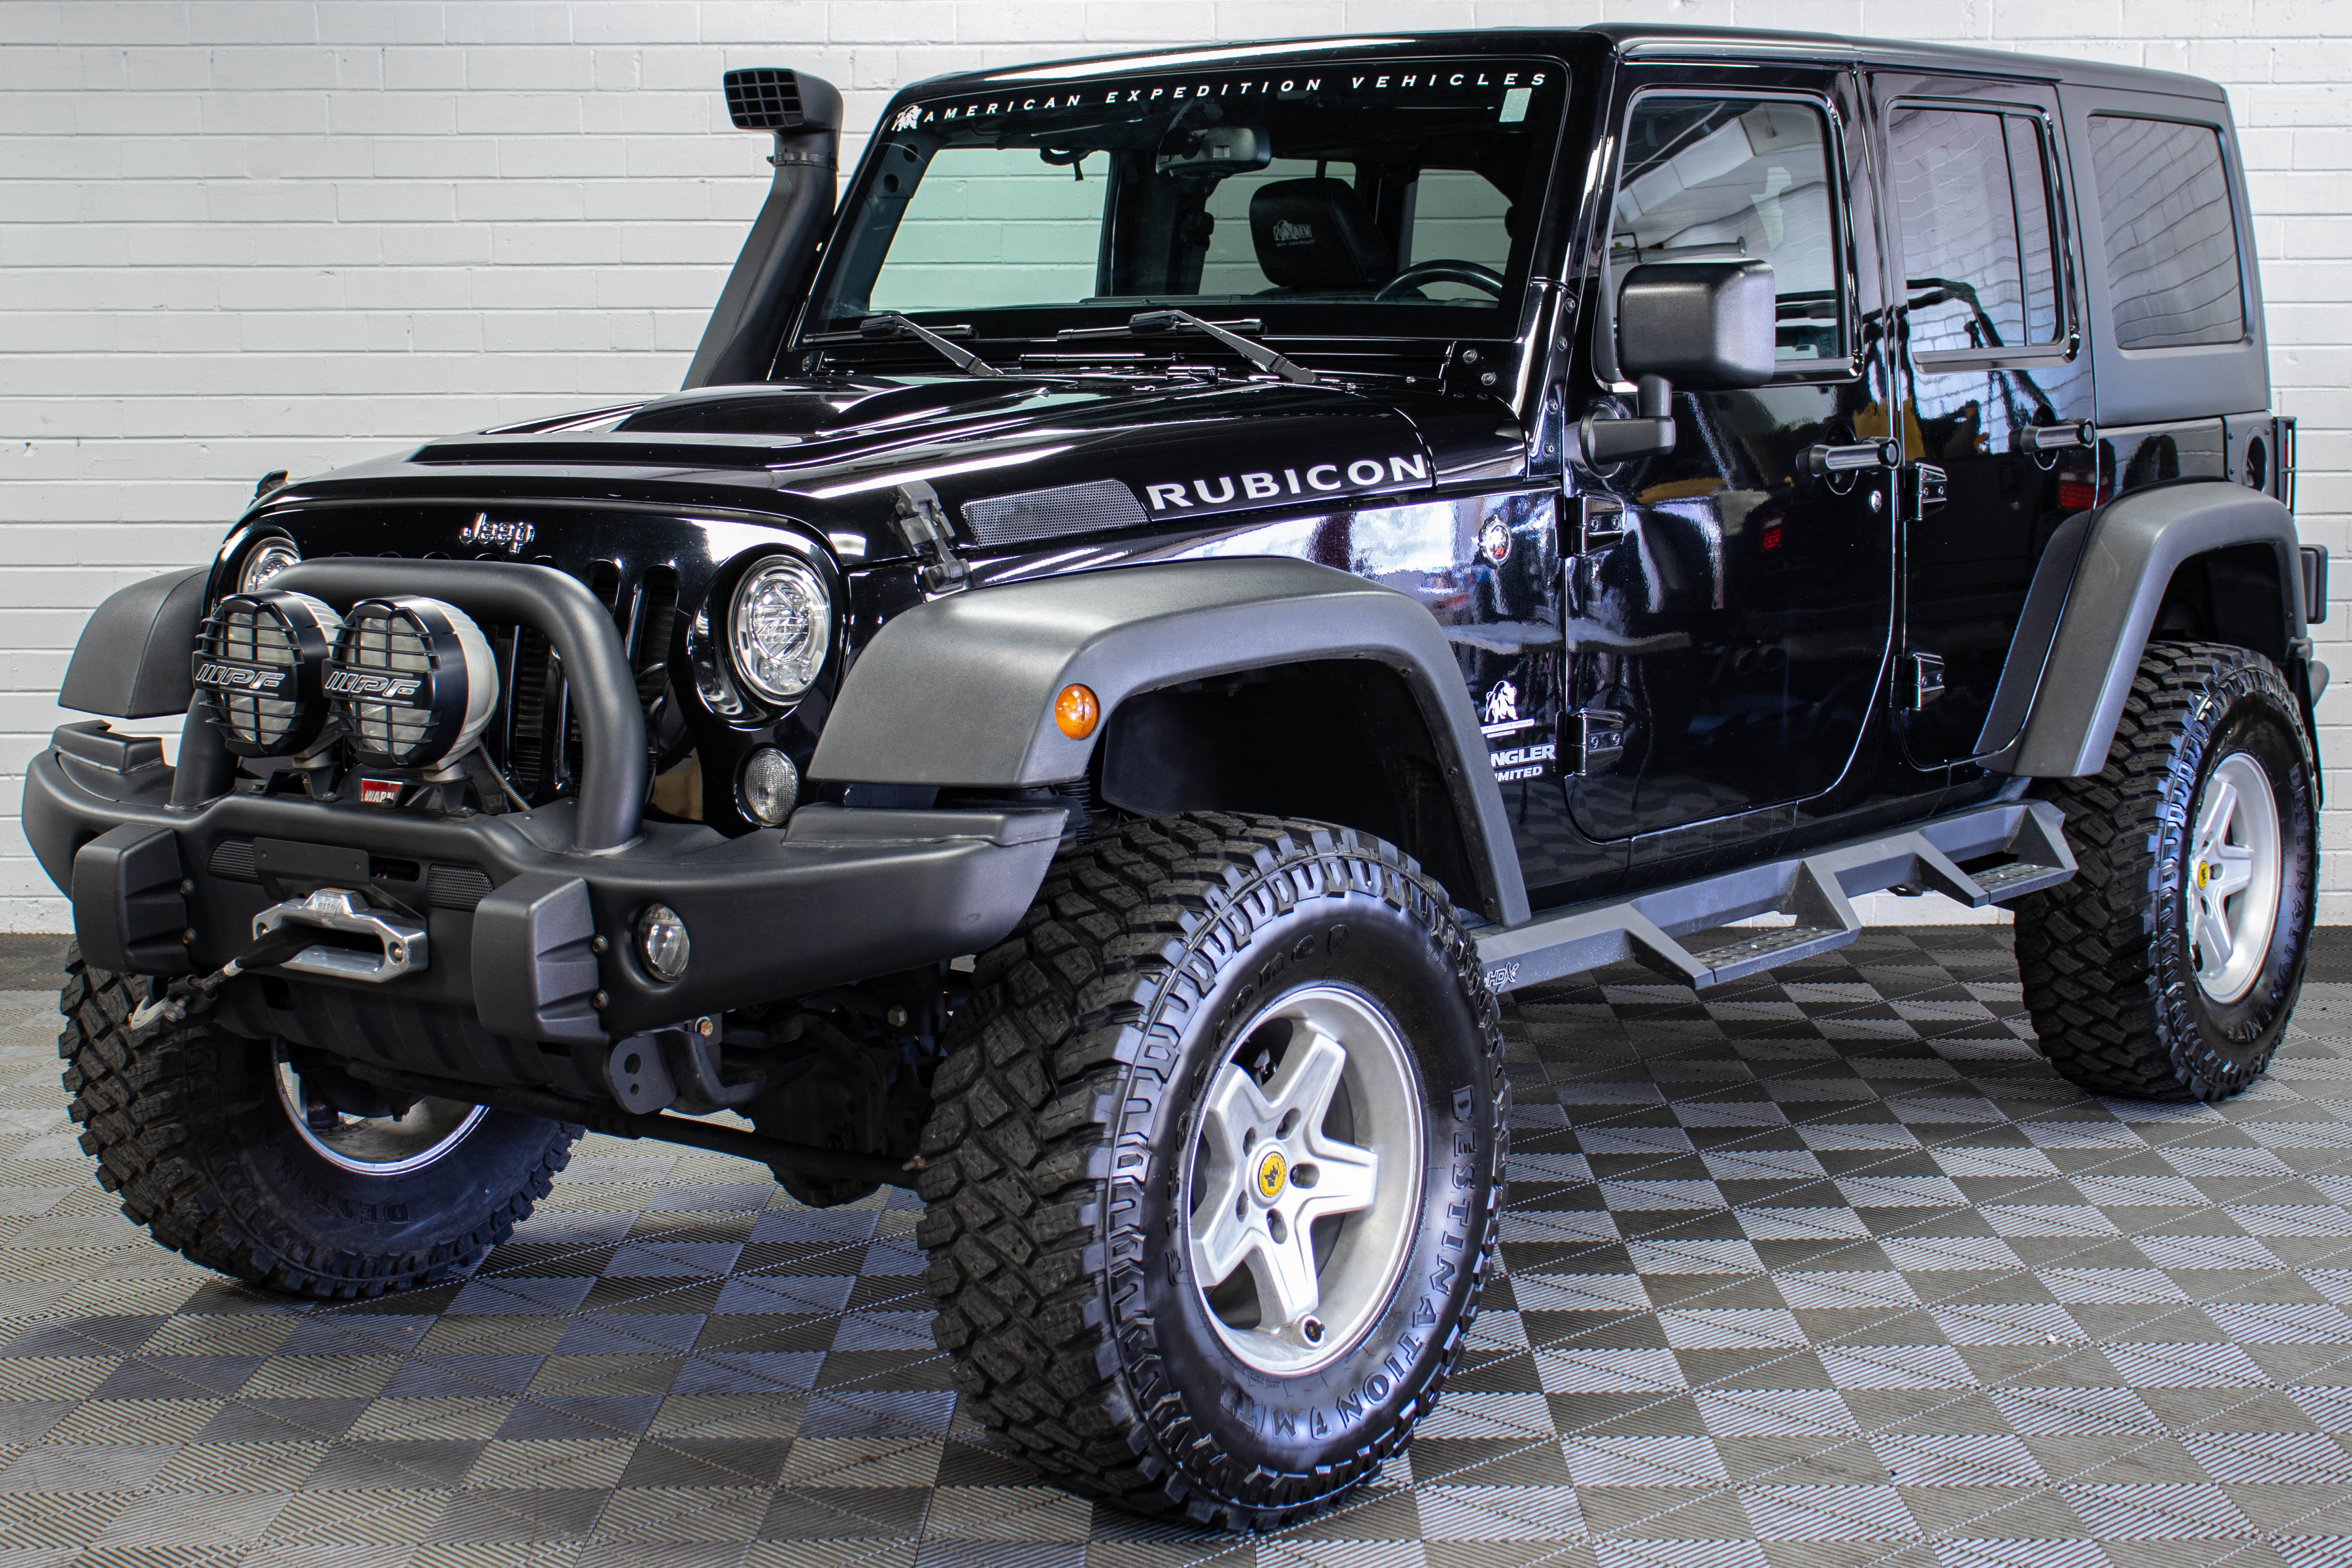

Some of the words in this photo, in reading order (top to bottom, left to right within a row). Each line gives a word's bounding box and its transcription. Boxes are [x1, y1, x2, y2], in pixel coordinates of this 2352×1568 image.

[923, 95, 1080, 123] AMERICAN
[1105, 78, 1322, 104] EXPEDITION
[1351, 73, 1546, 90] VEHICLES
[1145, 454, 1428, 510] RUBICON
[459, 512, 535, 554] Jeep
[1490, 744, 1556, 767] NGLER
[1495, 766, 1542, 782] IMITED
[2270, 762, 2310, 1004] DESTINATION
[1336, 1085, 1476, 1429] DESTINATION
